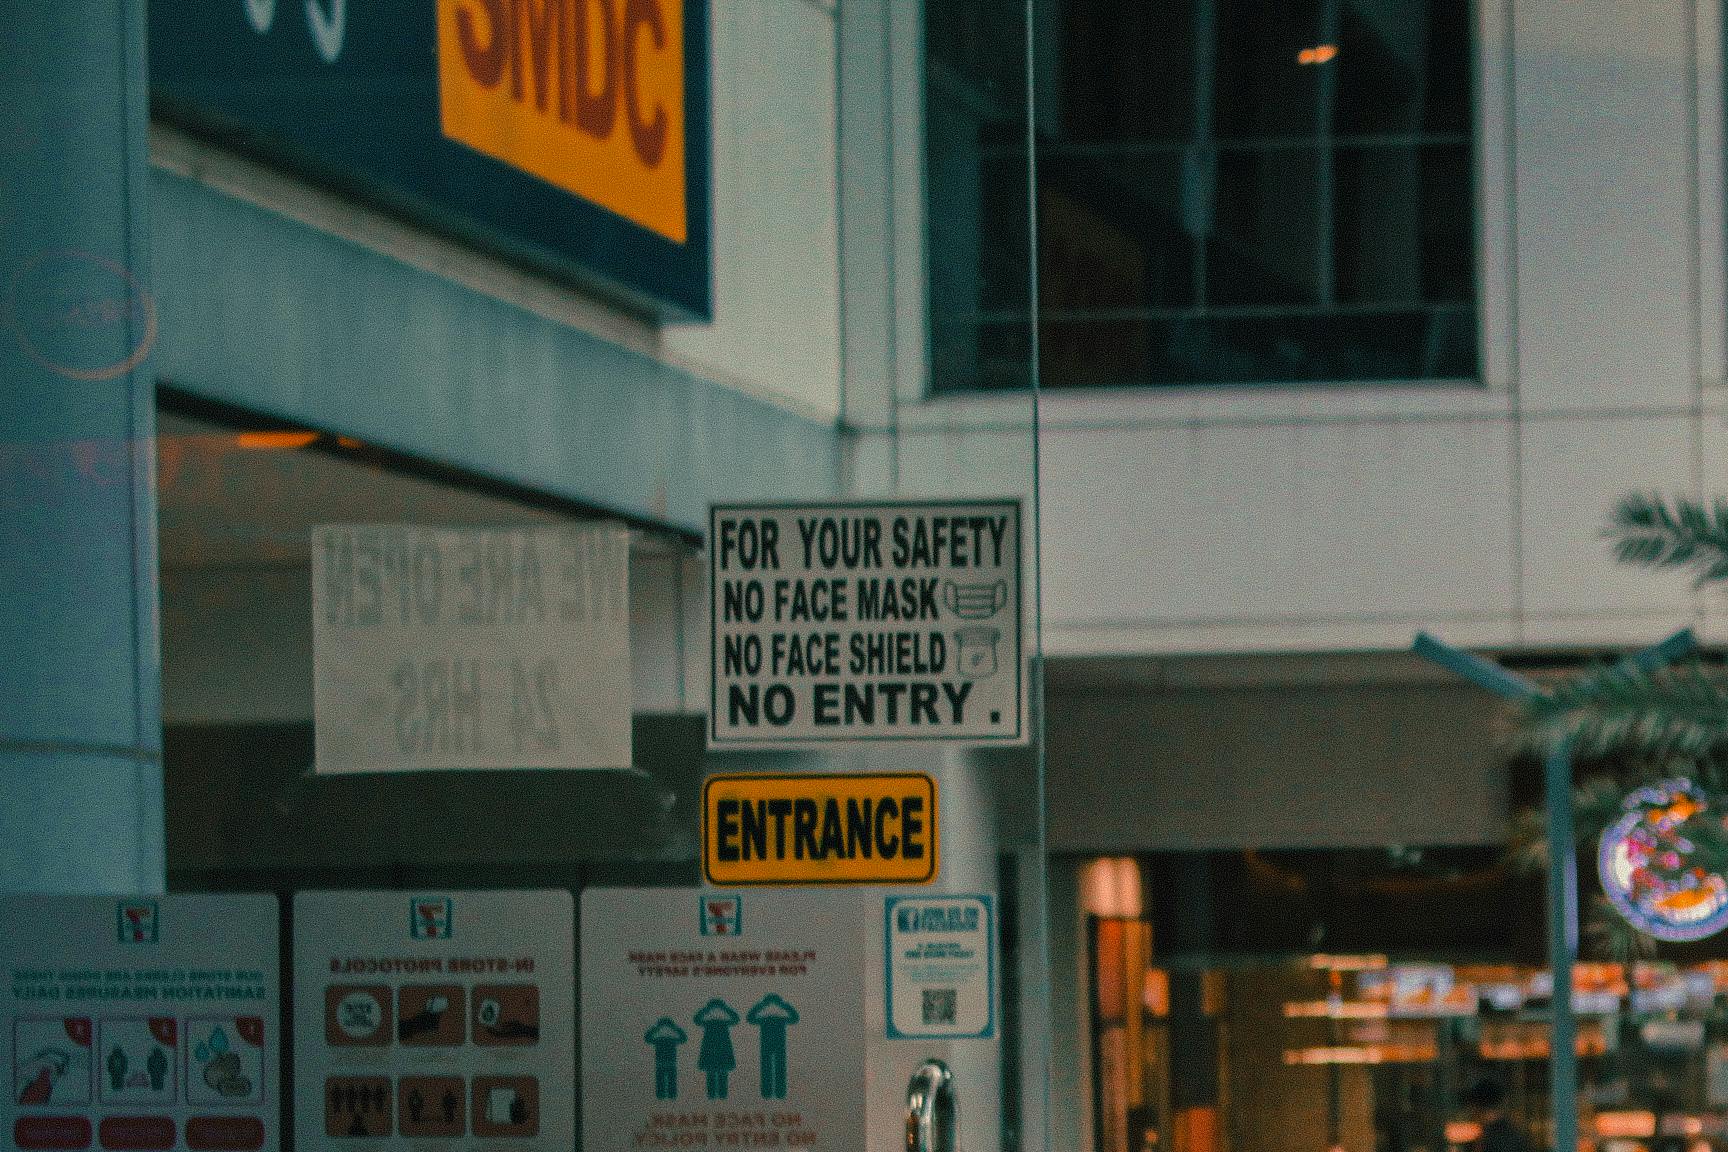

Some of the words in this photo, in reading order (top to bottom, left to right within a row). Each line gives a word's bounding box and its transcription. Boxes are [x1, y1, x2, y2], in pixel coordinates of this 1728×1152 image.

[720, 518, 780, 570] FOR
[798, 517, 883, 570] YOUR
[892, 515, 1008, 569] SAFETY
[724, 579, 765, 622] NO
[774, 578, 848, 622] FACE
[857, 577, 940, 621] MASK
[724, 634, 762, 677] NO
[771, 633, 842, 676] FACE
[849, 632, 947, 675] SHIELD
[728, 683, 797, 727] NO
[812, 681, 974, 726] ENTRY
[716, 797, 924, 861] ENTRANCE
